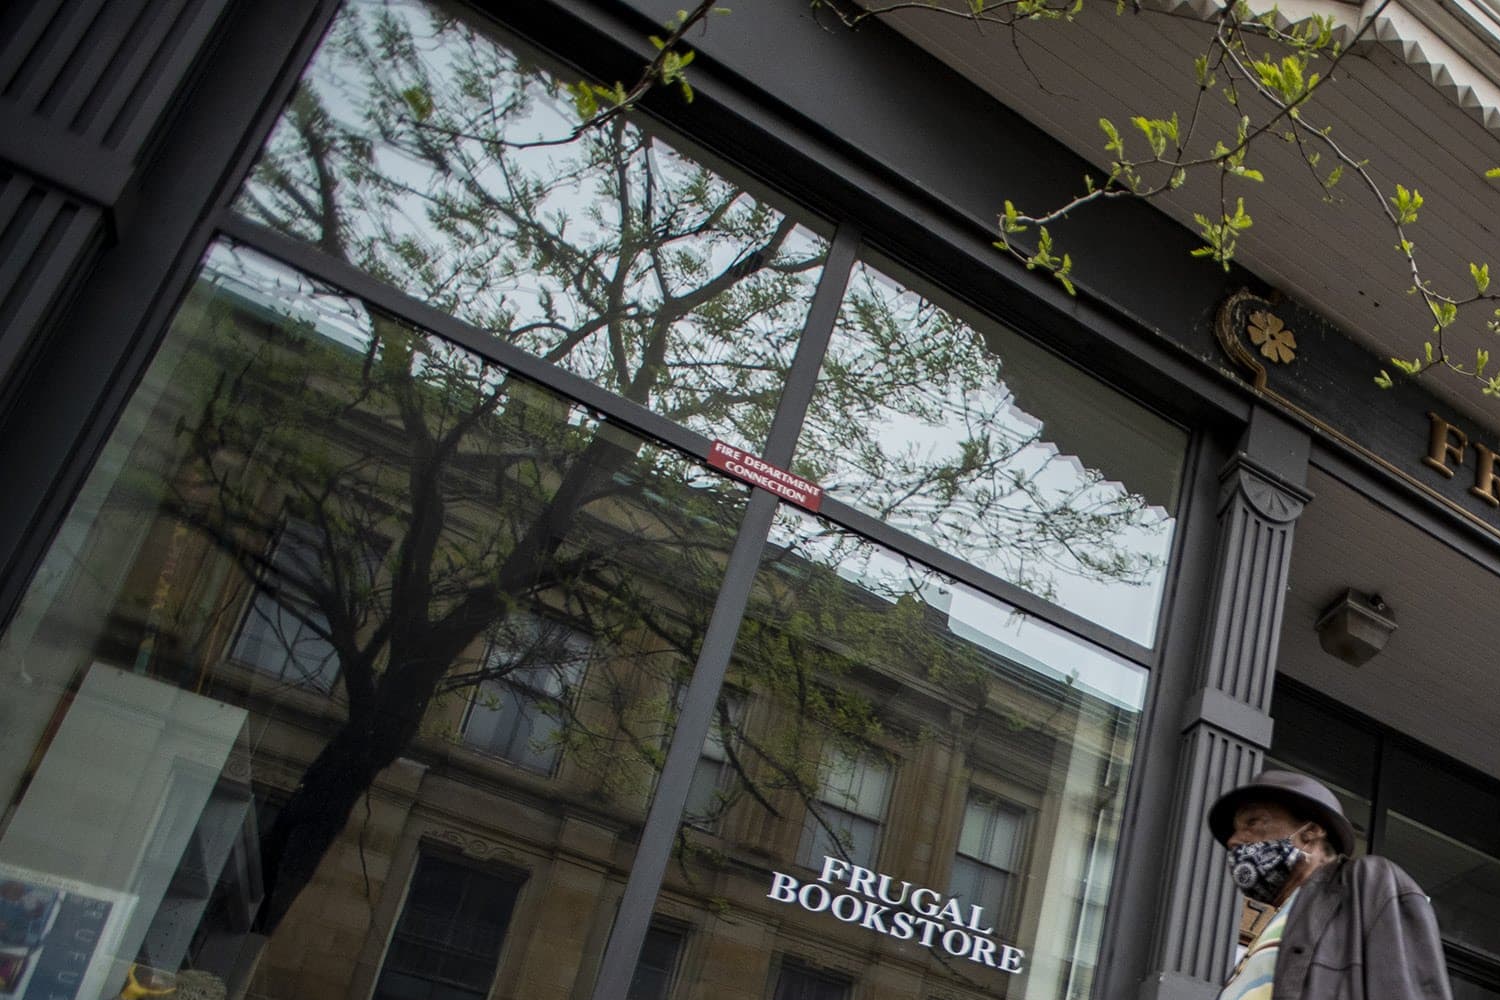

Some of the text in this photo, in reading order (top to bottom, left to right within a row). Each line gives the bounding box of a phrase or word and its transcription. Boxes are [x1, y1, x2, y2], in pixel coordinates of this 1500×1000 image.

[715, 442, 821, 496] FIRE DEPARTMENT
[725, 460, 806, 503] CONNECTION
[766, 871, 1025, 974] BOOKSTORE
[817, 855, 994, 935] FRUGAL
